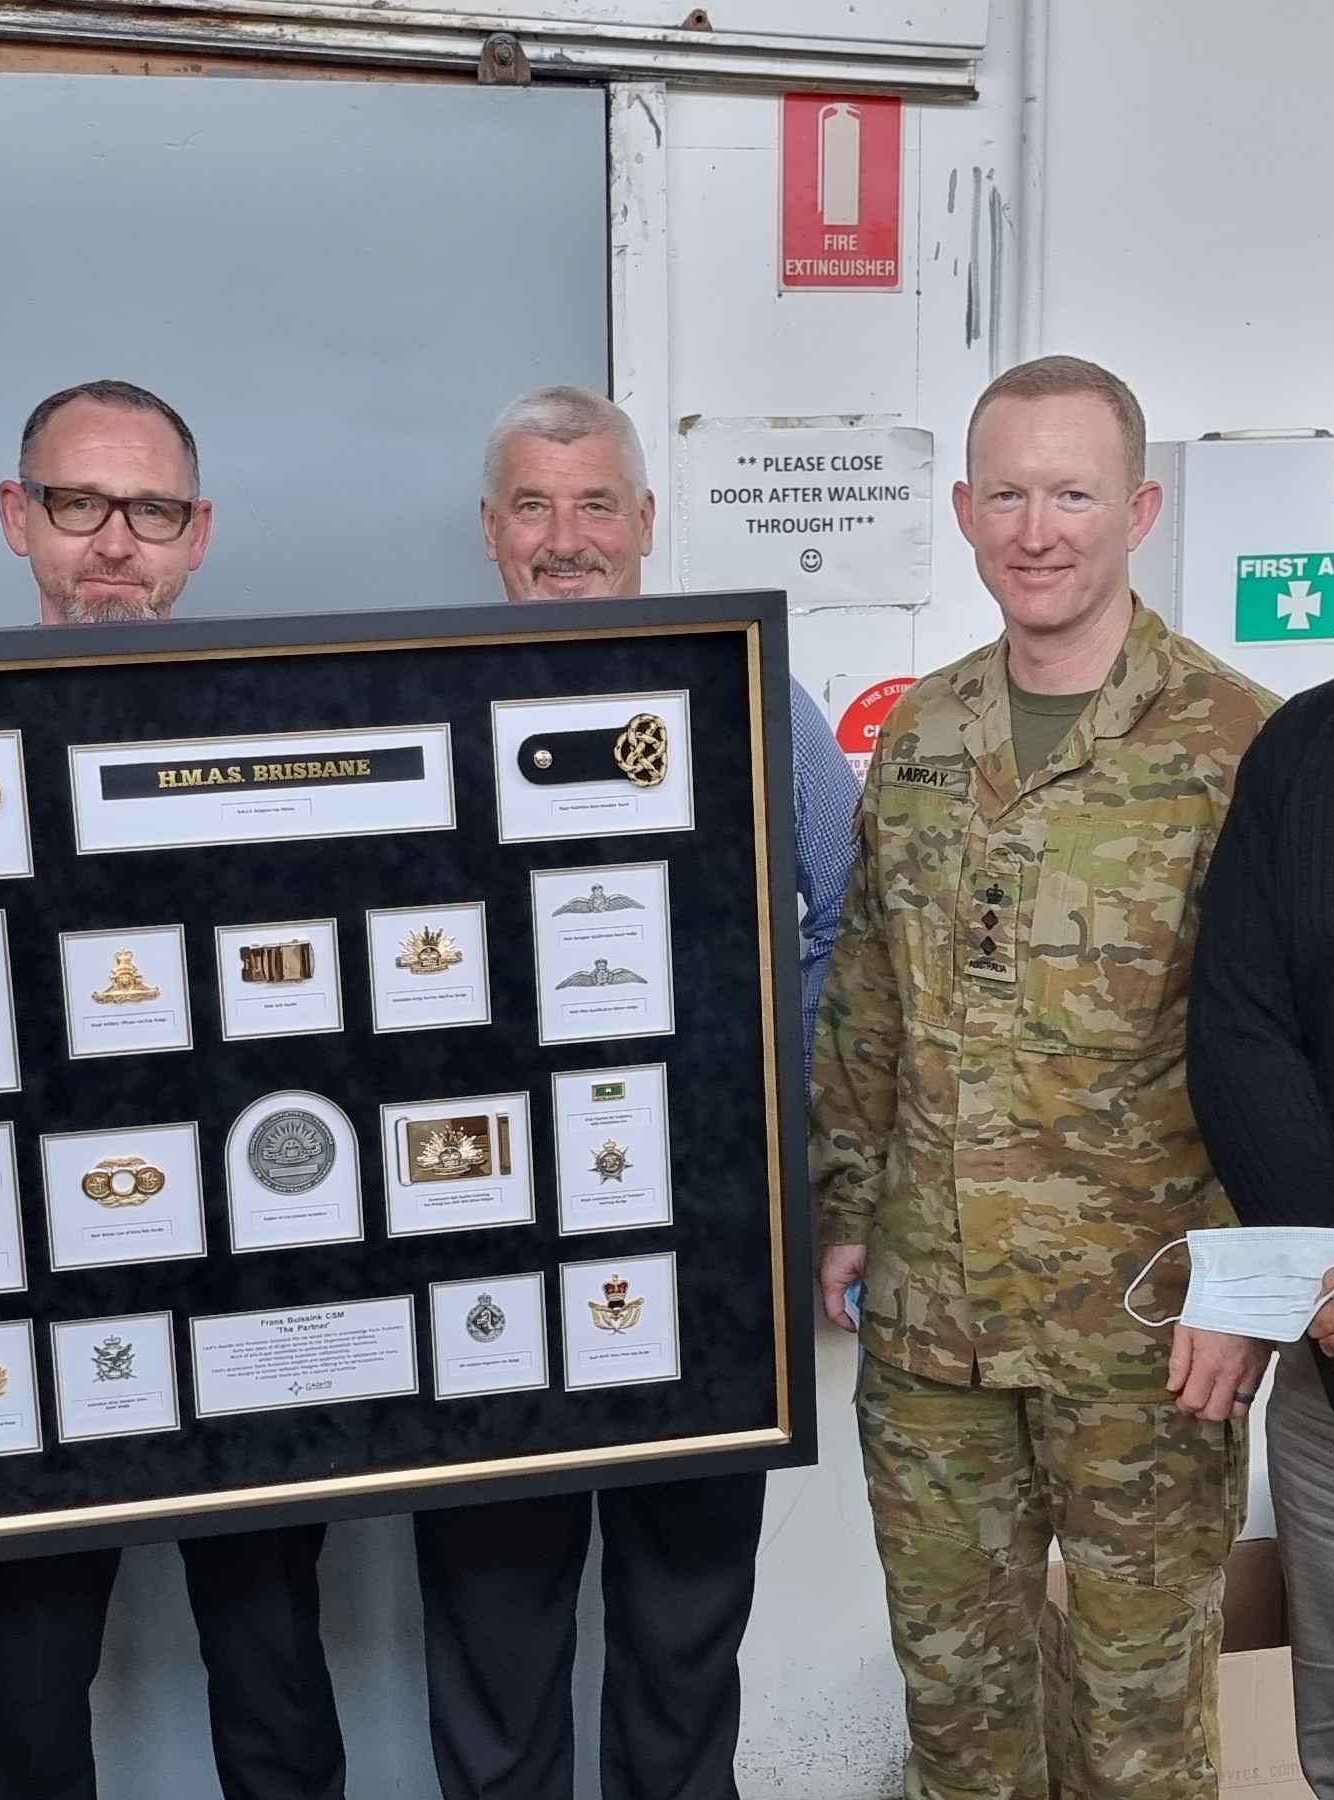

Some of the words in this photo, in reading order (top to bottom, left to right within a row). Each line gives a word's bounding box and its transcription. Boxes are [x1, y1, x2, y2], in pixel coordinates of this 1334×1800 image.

[824, 234, 858, 251] FIRE
[785, 259, 896, 276] EXTINGUISHER
[763, 456, 825, 472] PLEASE
[830, 455, 884, 471] CLOSE
[710, 488, 763, 504] DOOR
[768, 487, 823, 503] AFTER
[827, 485, 910, 502] WALKING
[745, 517, 833, 534] THROUGH
[1240, 557, 1309, 579] FIRST
[860, 690, 882, 709] THIS
[157, 765, 246, 788] H.M.A.S.
[253, 758, 371, 782] BRISBANE
